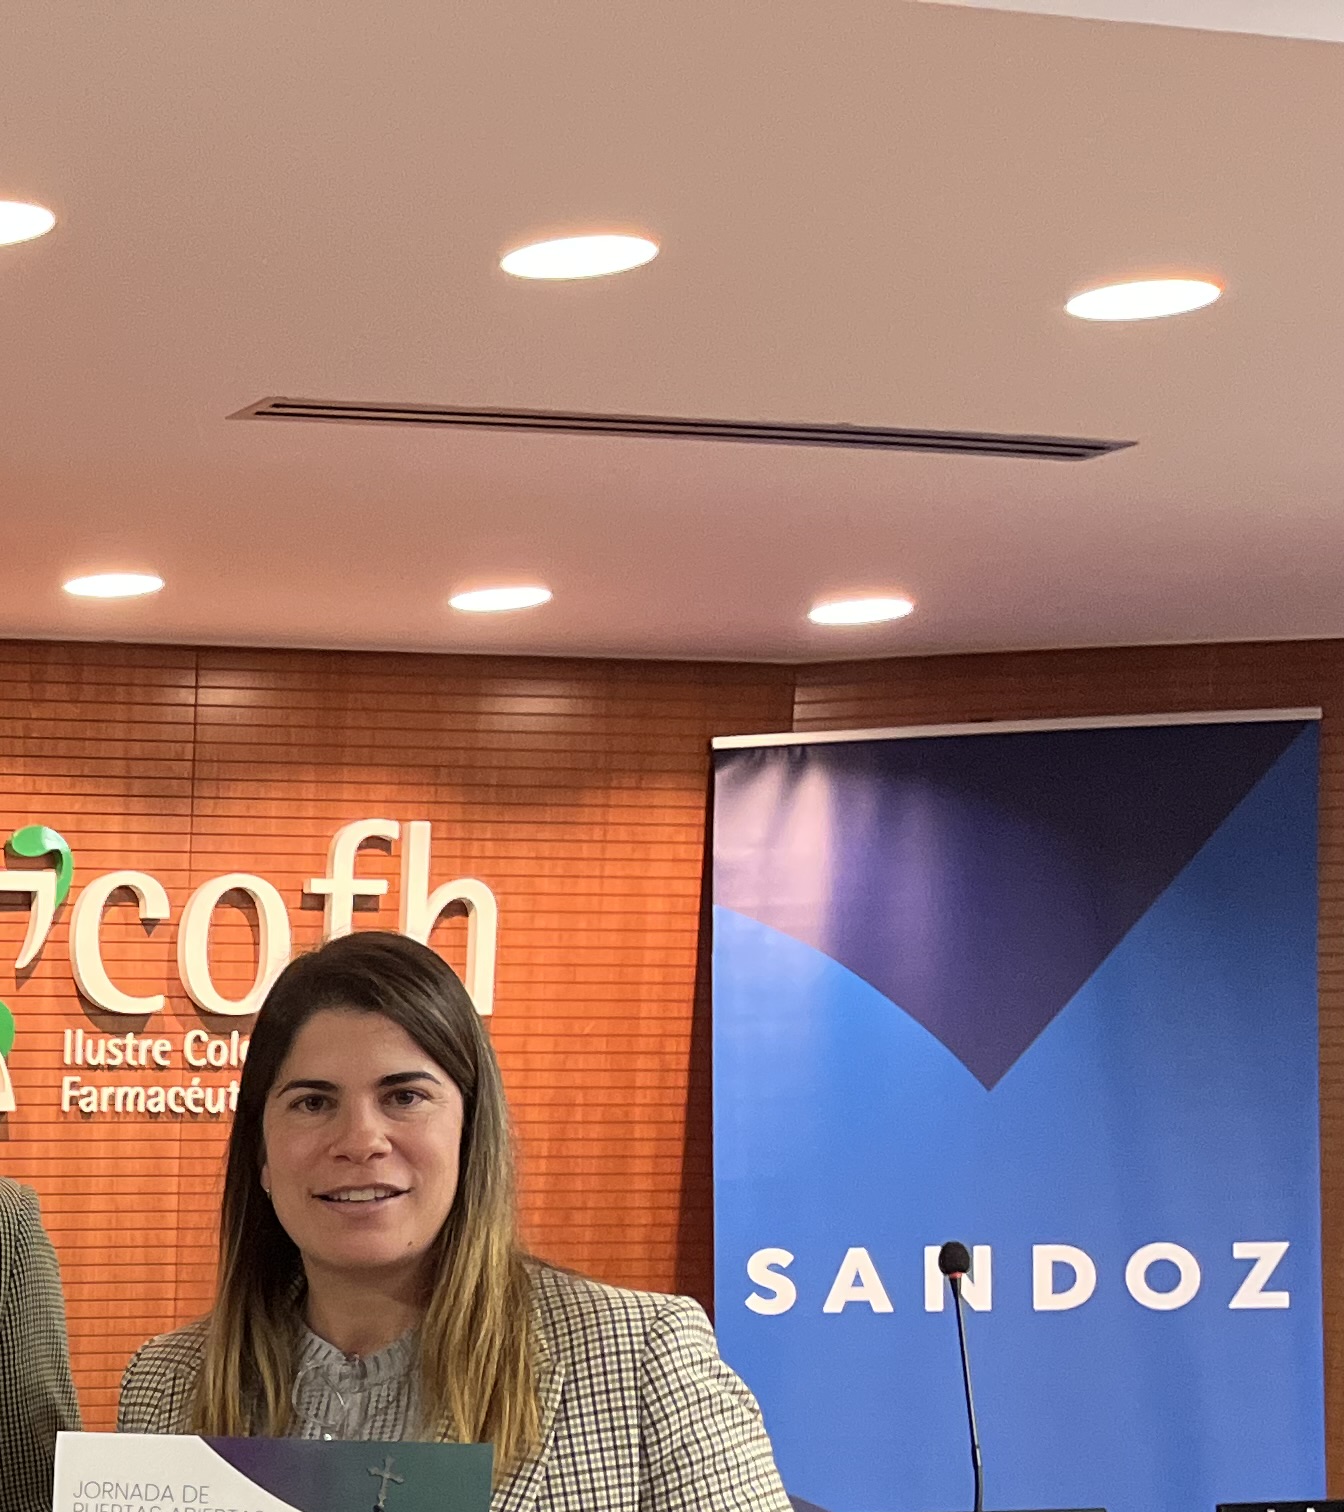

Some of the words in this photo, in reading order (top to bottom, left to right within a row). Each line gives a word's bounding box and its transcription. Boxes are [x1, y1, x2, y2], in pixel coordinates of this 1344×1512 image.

[69, 819, 497, 1016] cofh
[63, 1028, 172, 1066] Ilustre
[744, 1242, 1290, 1316] SANDOZ
[73, 1480, 174, 1502] JORNADA
[182, 1485, 210, 1504] DE
